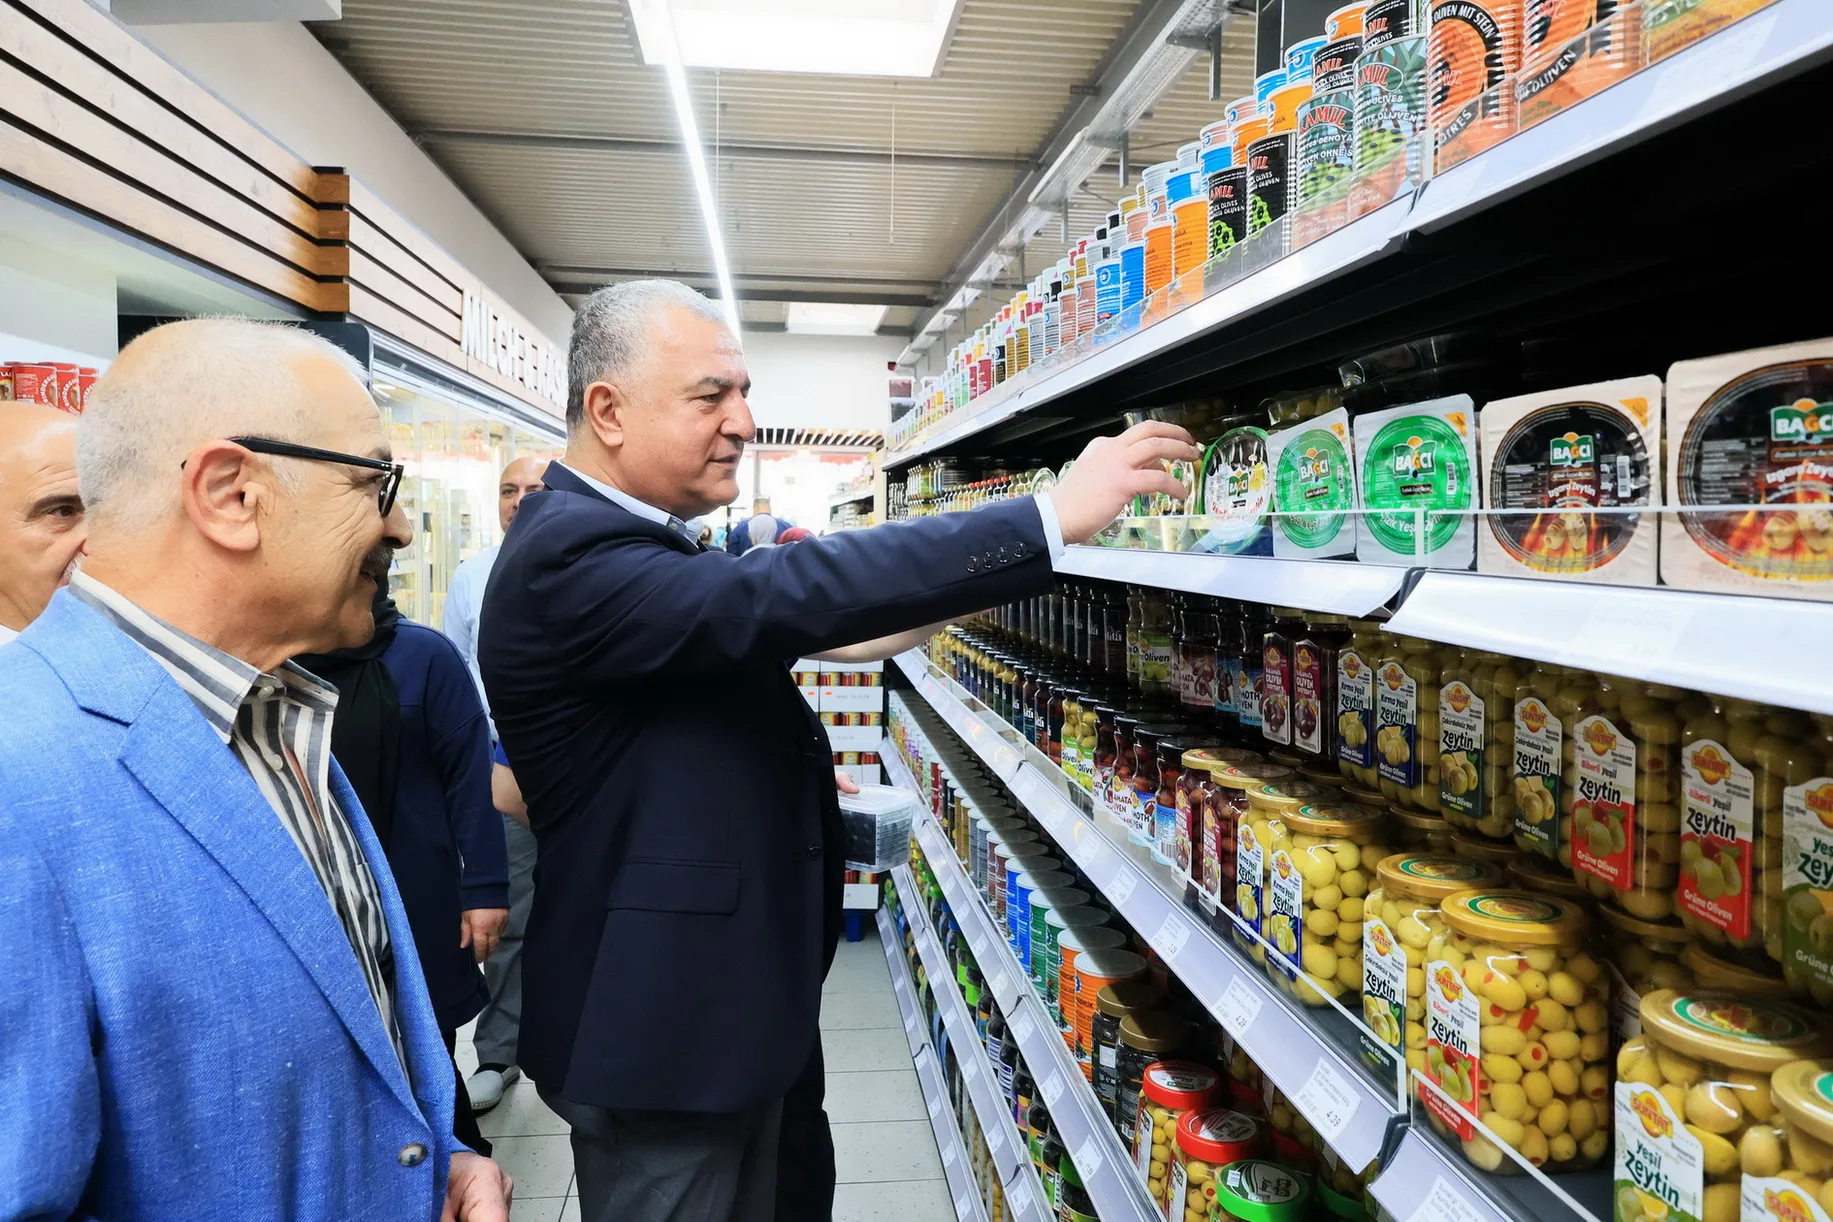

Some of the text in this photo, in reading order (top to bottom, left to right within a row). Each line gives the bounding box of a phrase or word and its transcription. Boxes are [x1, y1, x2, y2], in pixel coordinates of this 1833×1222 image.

[1433, 4, 1458, 22] OLIVEN
[1458, 4, 1475, 21] MIT
[1300, 106, 1346, 134] AMIL
[1317, 134, 1354, 145] DENOYA
[1798, 852, 1833, 886] zey
[1796, 949, 1829, 972] Grüne
